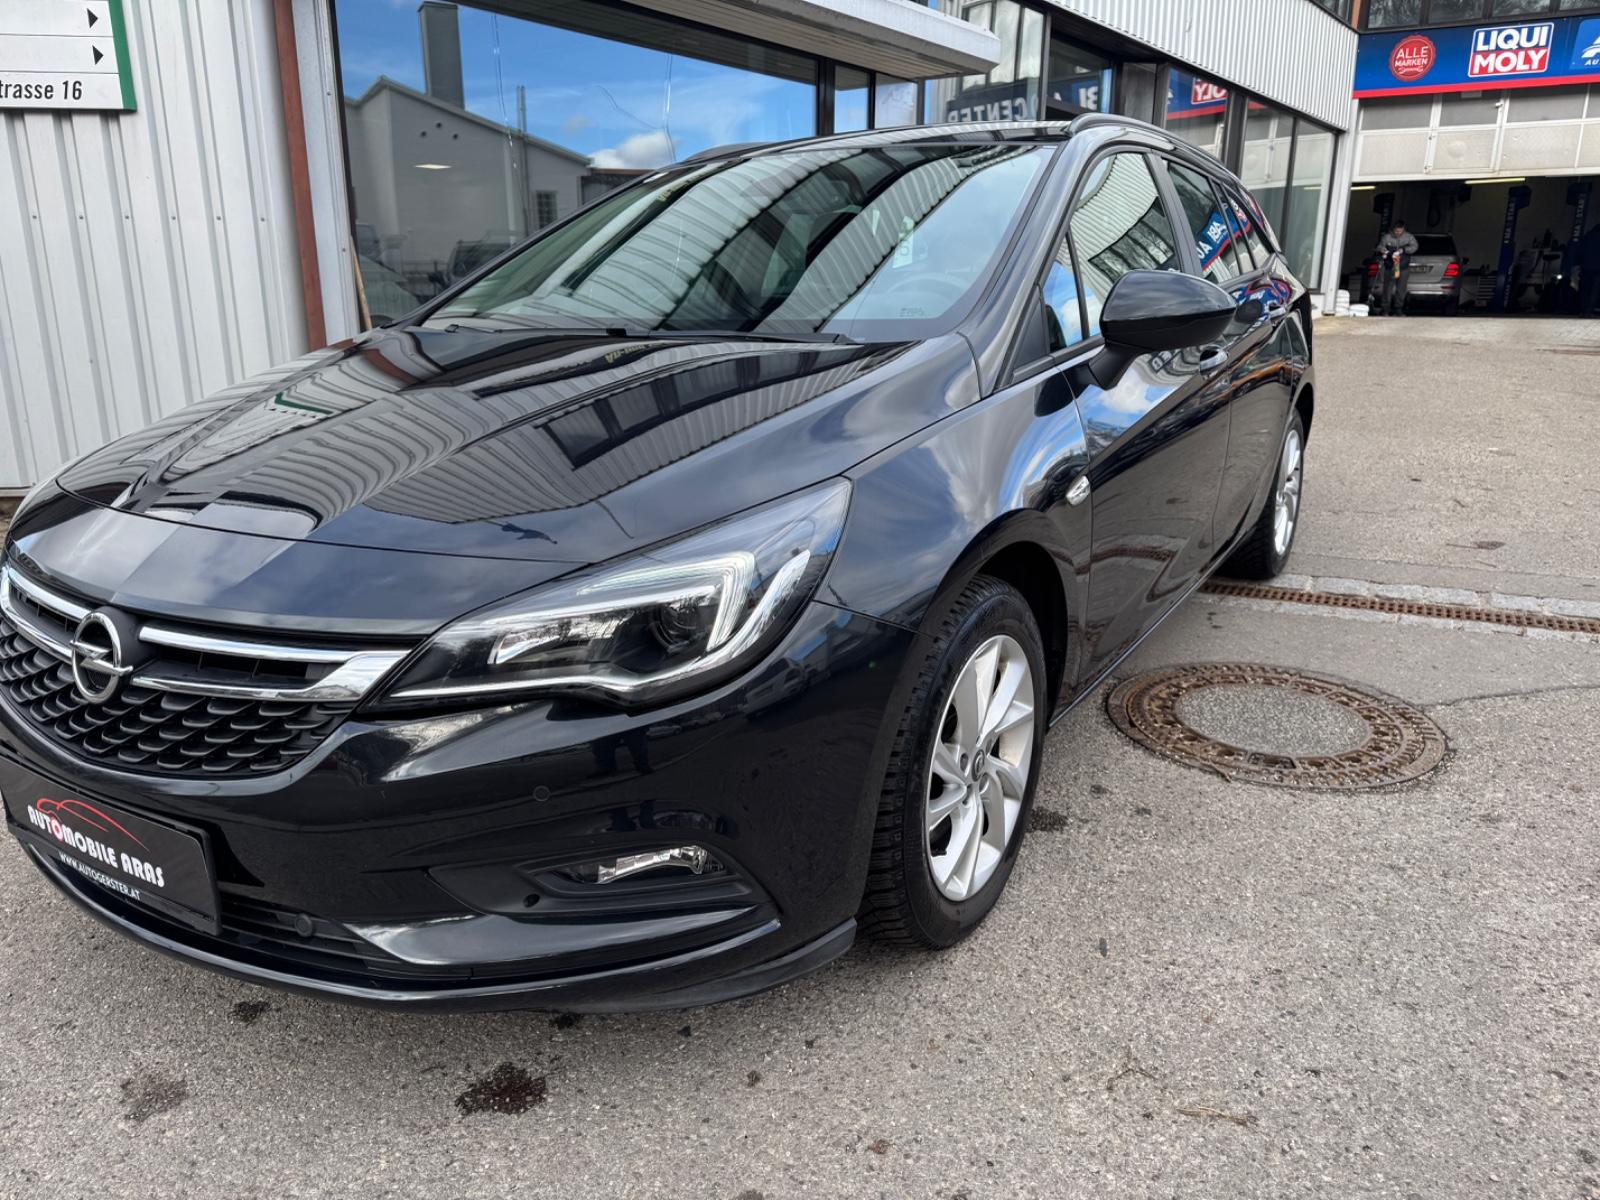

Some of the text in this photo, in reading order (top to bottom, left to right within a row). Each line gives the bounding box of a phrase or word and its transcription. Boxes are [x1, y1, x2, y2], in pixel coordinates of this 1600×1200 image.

[1476, 26, 1549, 50] LIQUI
[1394, 58, 1428, 68] MARKEN
[1396, 46, 1429, 59] ALLE
[1472, 49, 1548, 74] MOLY
[62, 80, 83, 100] 16
[27, 804, 165, 888] AUTOMOBILE ARAS
